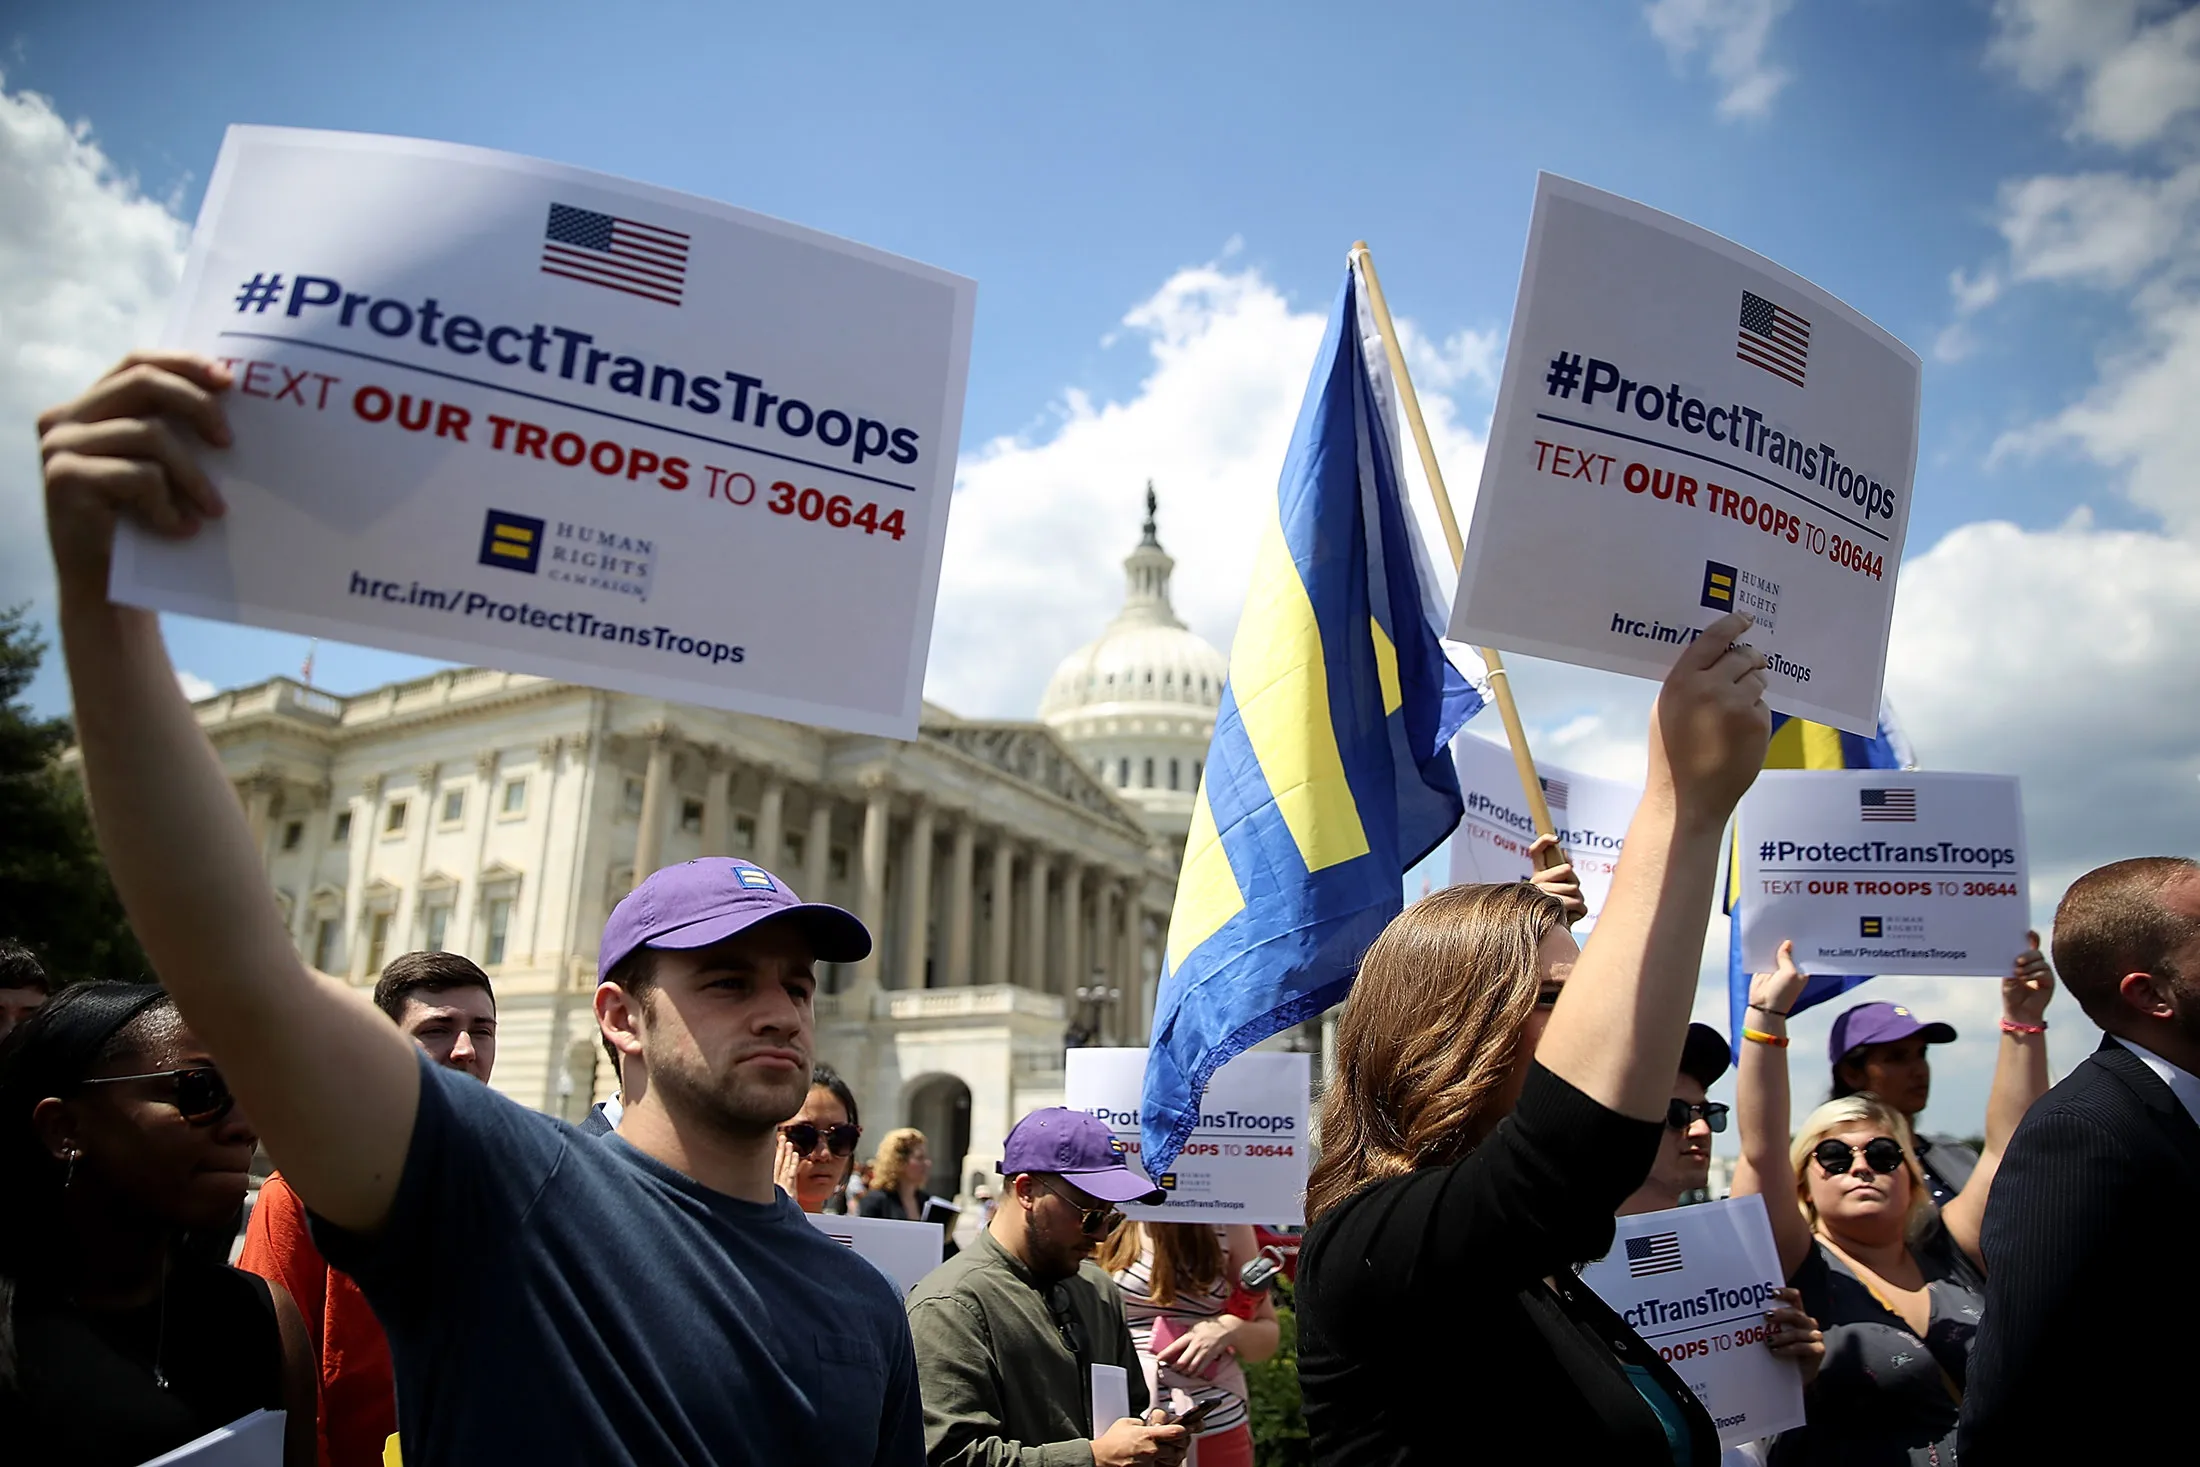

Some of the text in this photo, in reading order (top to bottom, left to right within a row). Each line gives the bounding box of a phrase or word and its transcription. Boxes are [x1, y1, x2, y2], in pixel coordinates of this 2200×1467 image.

[234, 272, 920, 465] #ProtectTransTroops
[1546, 350, 1896, 520] #ProtectTransTroops
[353, 385, 472, 442] OUR
[487, 414, 691, 491] TROOPS
[703, 464, 757, 506] TO
[766, 480, 907, 541] 30644
[1534, 440, 1884, 582] TEXT OUR TROOPS TO 30644
[555, 521, 655, 556] HUMAN
[551, 544, 650, 578] RIGHTS
[547, 567, 646, 597] CAMPAIGN
[1741, 570, 1781, 597] HUMAN
[348, 570, 746, 665] hrc.im/ProtectTransTroops
[1738, 590, 1778, 615] RIGHTS
[1493, 833, 1517, 854] OUR
[1759, 841, 2015, 869] #ProtectTransTroops
[1761, 880, 2017, 897] TEXT OUR TROOPS TO 30644
[1223, 1143, 1241, 1157] TO
[1244, 1144, 1294, 1157] 30644
[1622, 1281, 1776, 1329] ctTransTroops
[1659, 1339, 1709, 1364] OOPS
[1711, 1334, 1732, 1353] TO
